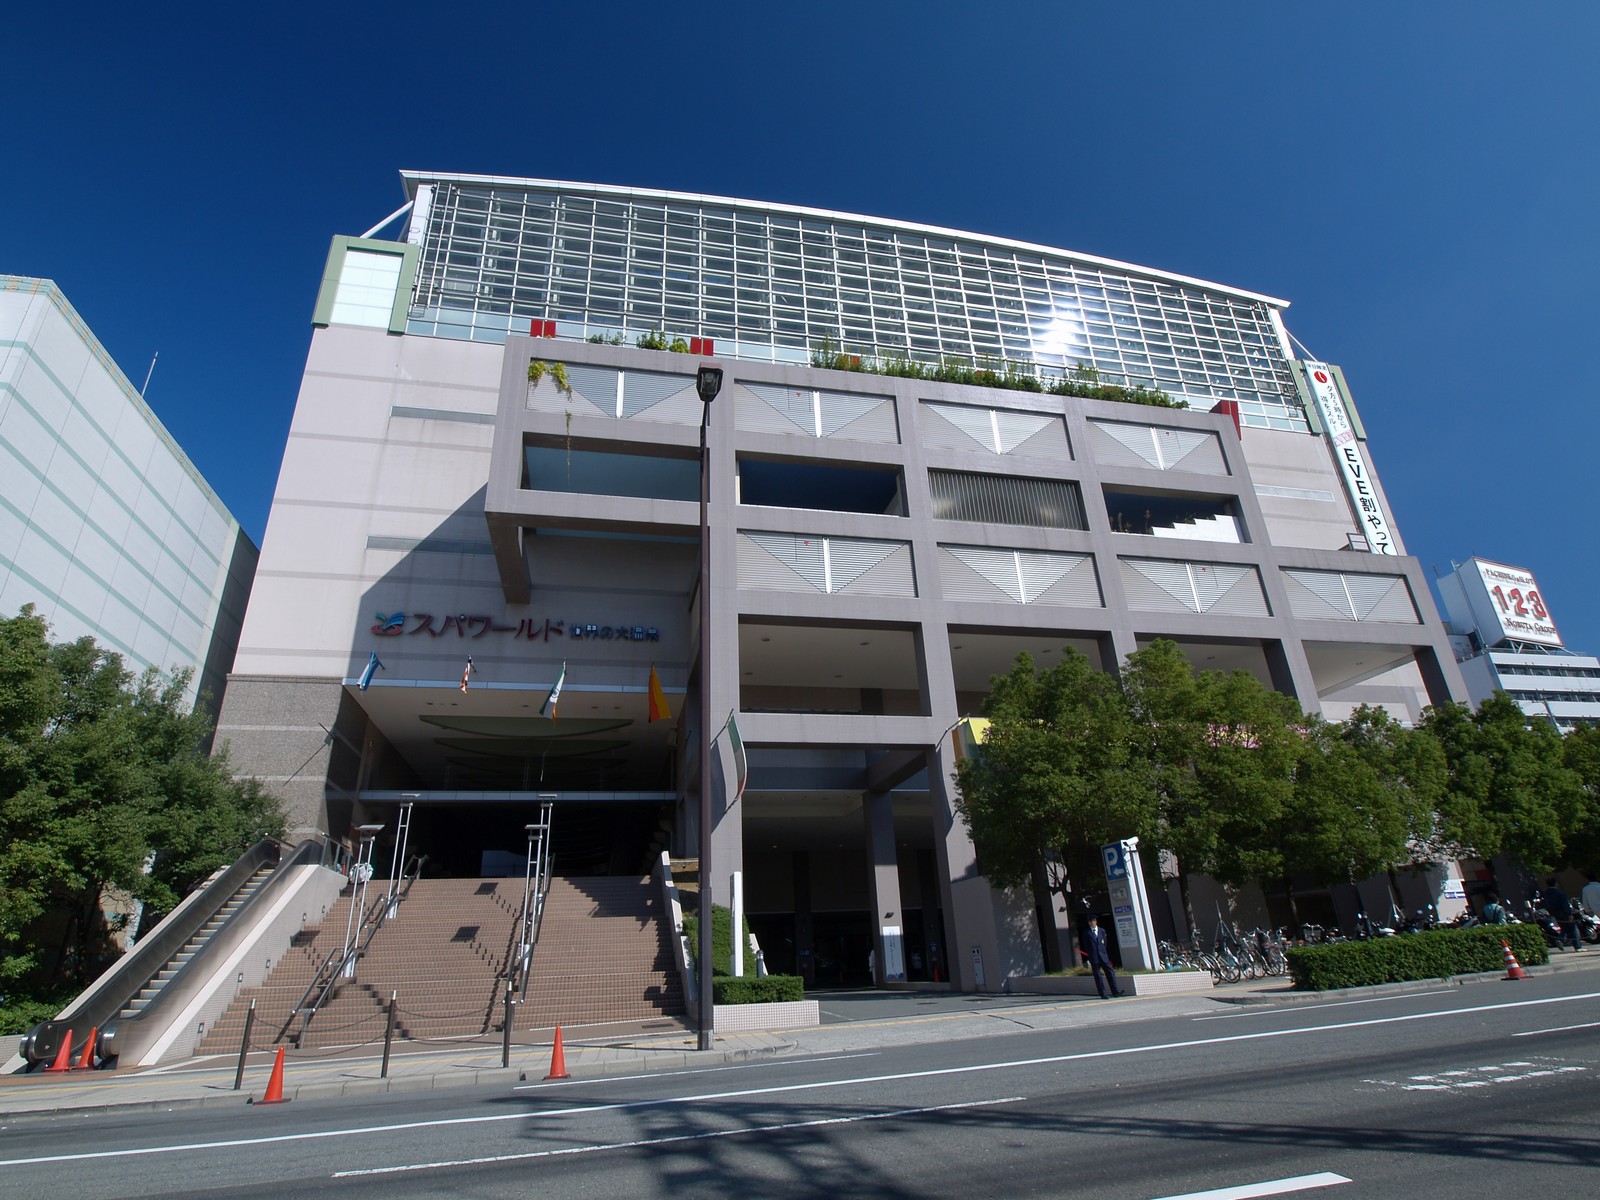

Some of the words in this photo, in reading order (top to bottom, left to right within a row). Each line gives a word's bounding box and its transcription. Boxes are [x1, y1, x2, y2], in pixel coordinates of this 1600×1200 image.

[1493, 585, 1547, 618] 123
[409, 613, 565, 642] スパワールド
[1103, 847, 1119, 876] P
